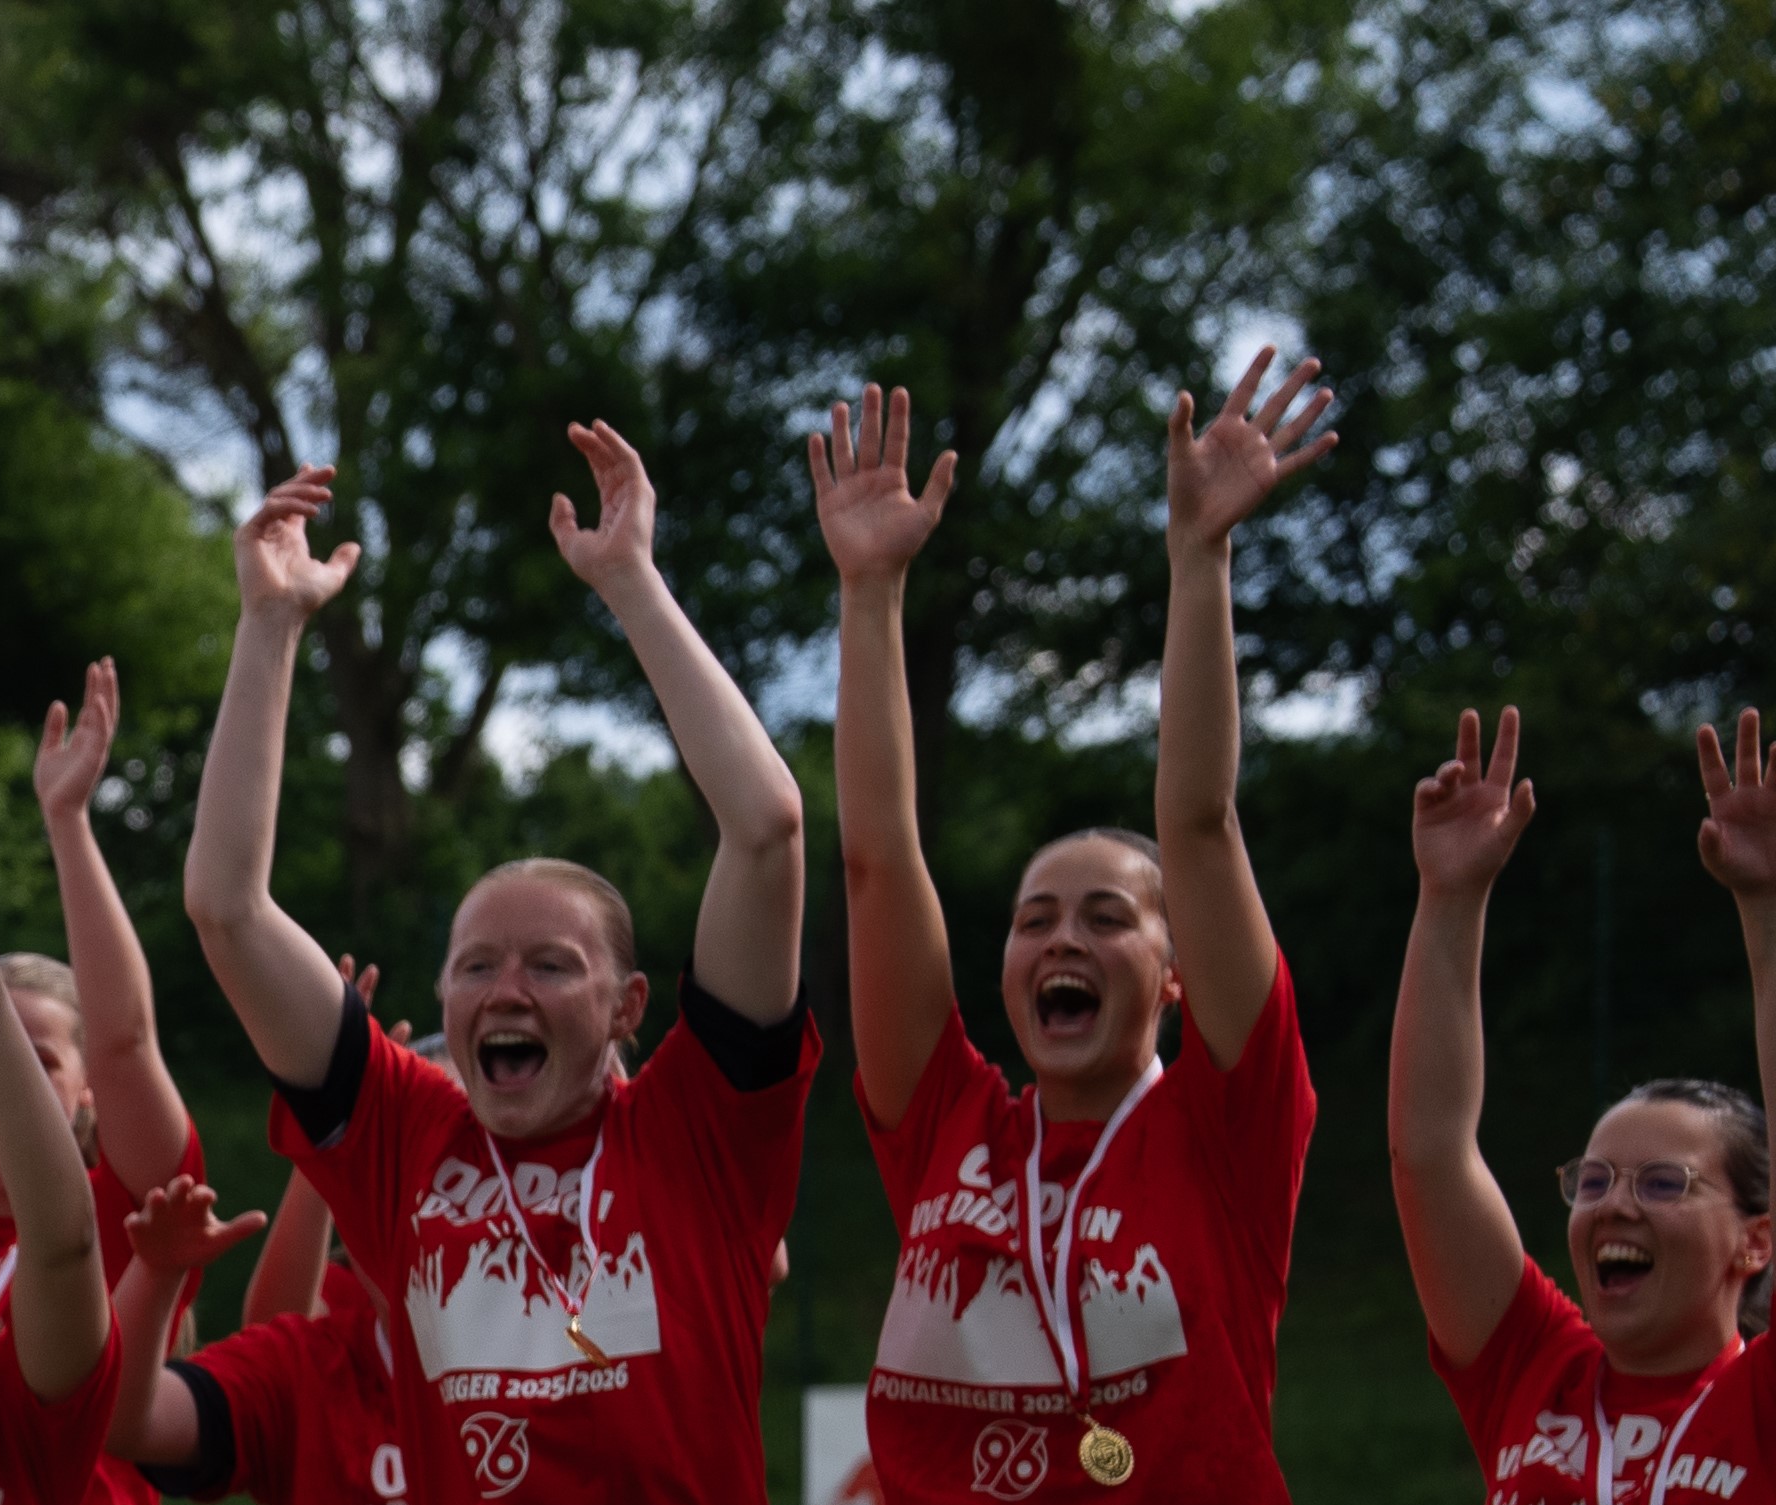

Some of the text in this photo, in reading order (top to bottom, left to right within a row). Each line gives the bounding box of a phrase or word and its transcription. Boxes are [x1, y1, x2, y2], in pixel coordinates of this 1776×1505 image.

[945, 1189, 1009, 1237] DID
[504, 1361, 630, 1401] 2025/2026
[872, 1372, 1016, 1413] POKALSIEGER
[970, 1418, 1048, 1501] 96
[1665, 1453, 1747, 1501] AIN
